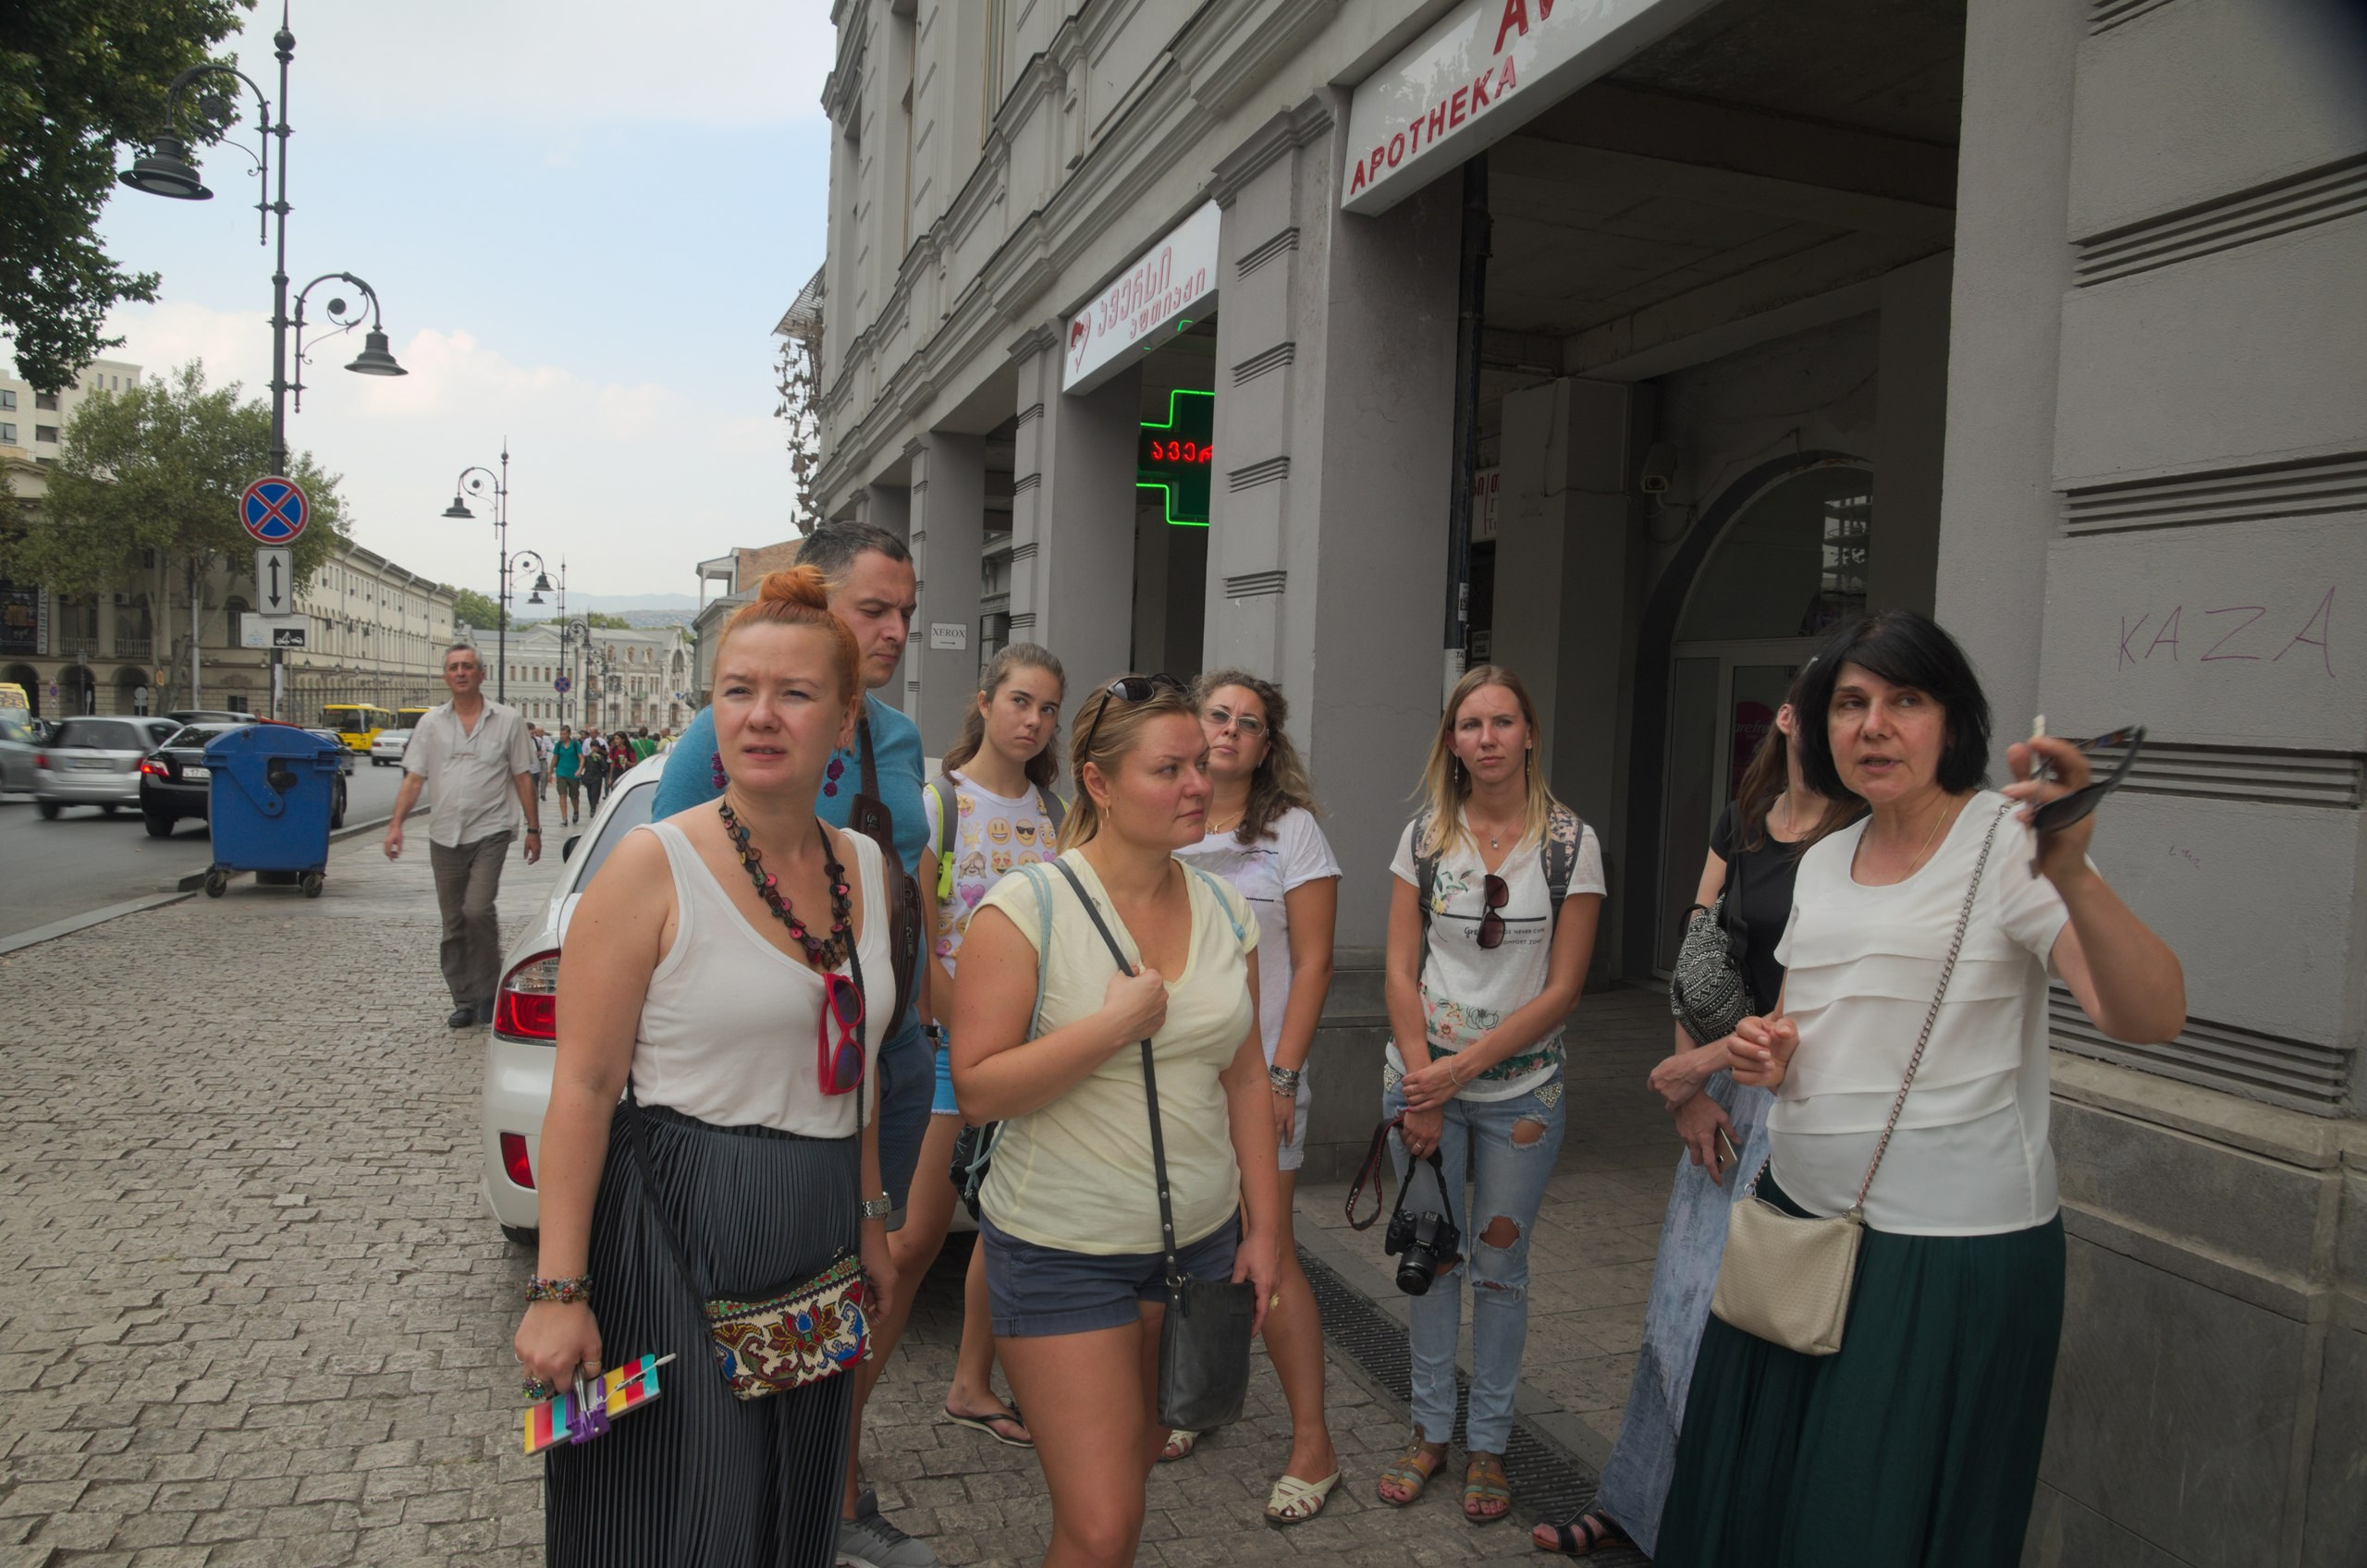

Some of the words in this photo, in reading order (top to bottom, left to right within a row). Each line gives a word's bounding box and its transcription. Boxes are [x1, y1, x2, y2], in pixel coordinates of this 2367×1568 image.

[1350, 55, 1516, 196] APOTHEKA
[1098, 245, 1171, 337] ავერსი
[932, 628, 966, 638] XEROX
[2116, 585, 2337, 680] KAZA
